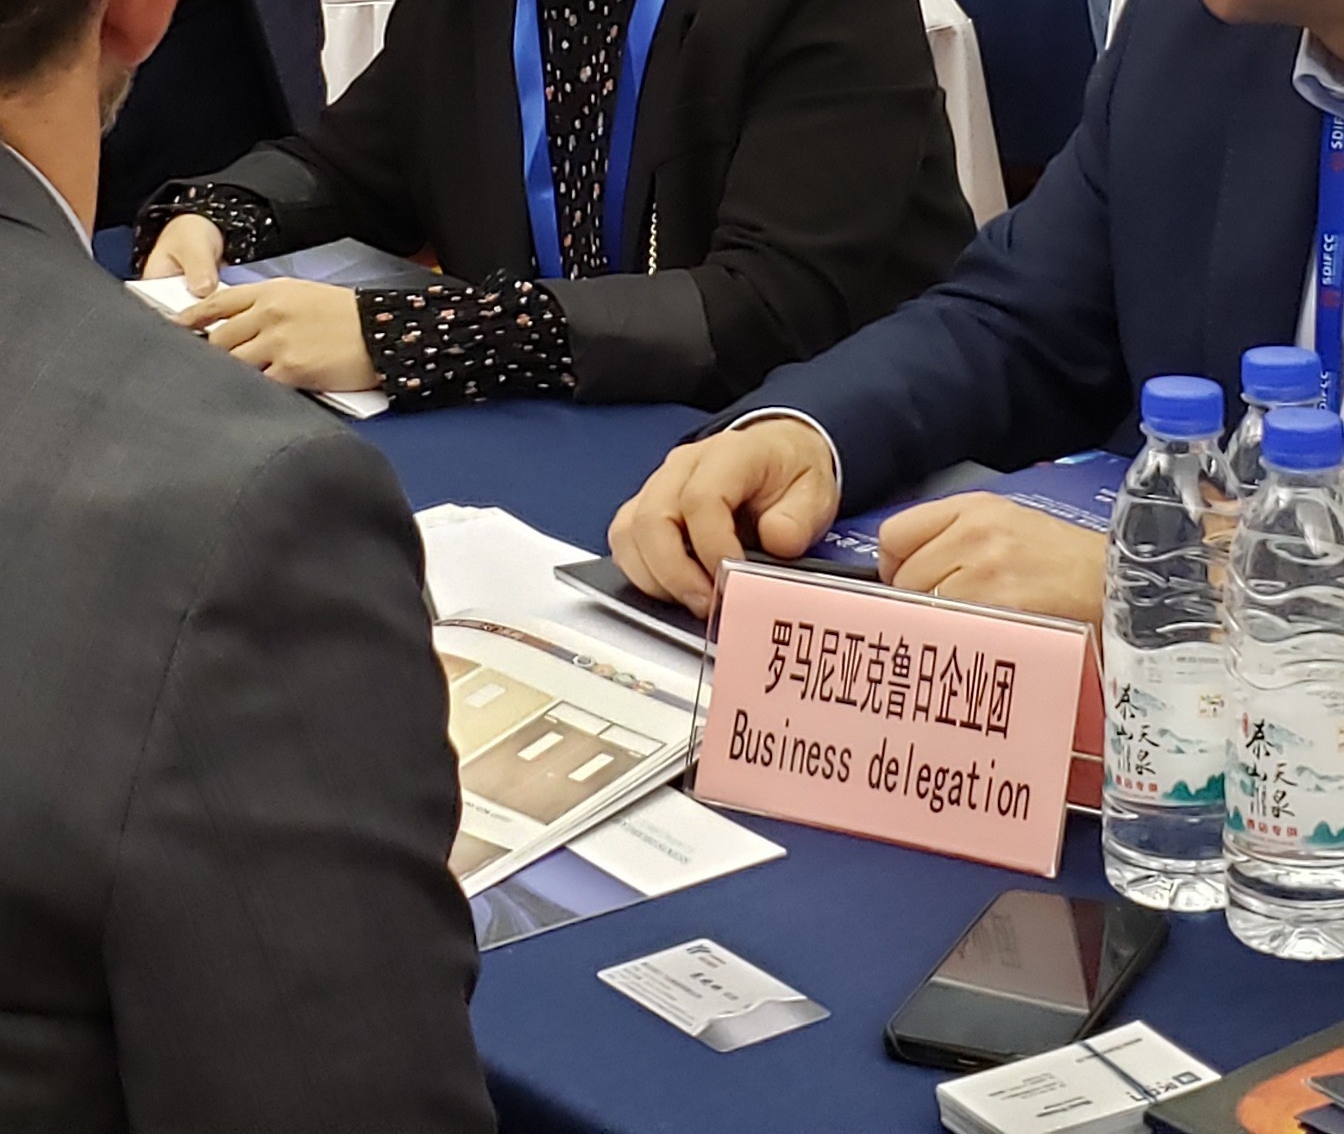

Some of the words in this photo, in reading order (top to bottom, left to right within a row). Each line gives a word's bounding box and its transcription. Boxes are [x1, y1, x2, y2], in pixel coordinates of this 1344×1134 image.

[1322, 232, 1336, 286] SDIFCC
[765, 619, 1016, 740] 罗马尼亚克鲁日企业团
[729, 708, 852, 784] Business
[869, 737, 1031, 820] delegation
